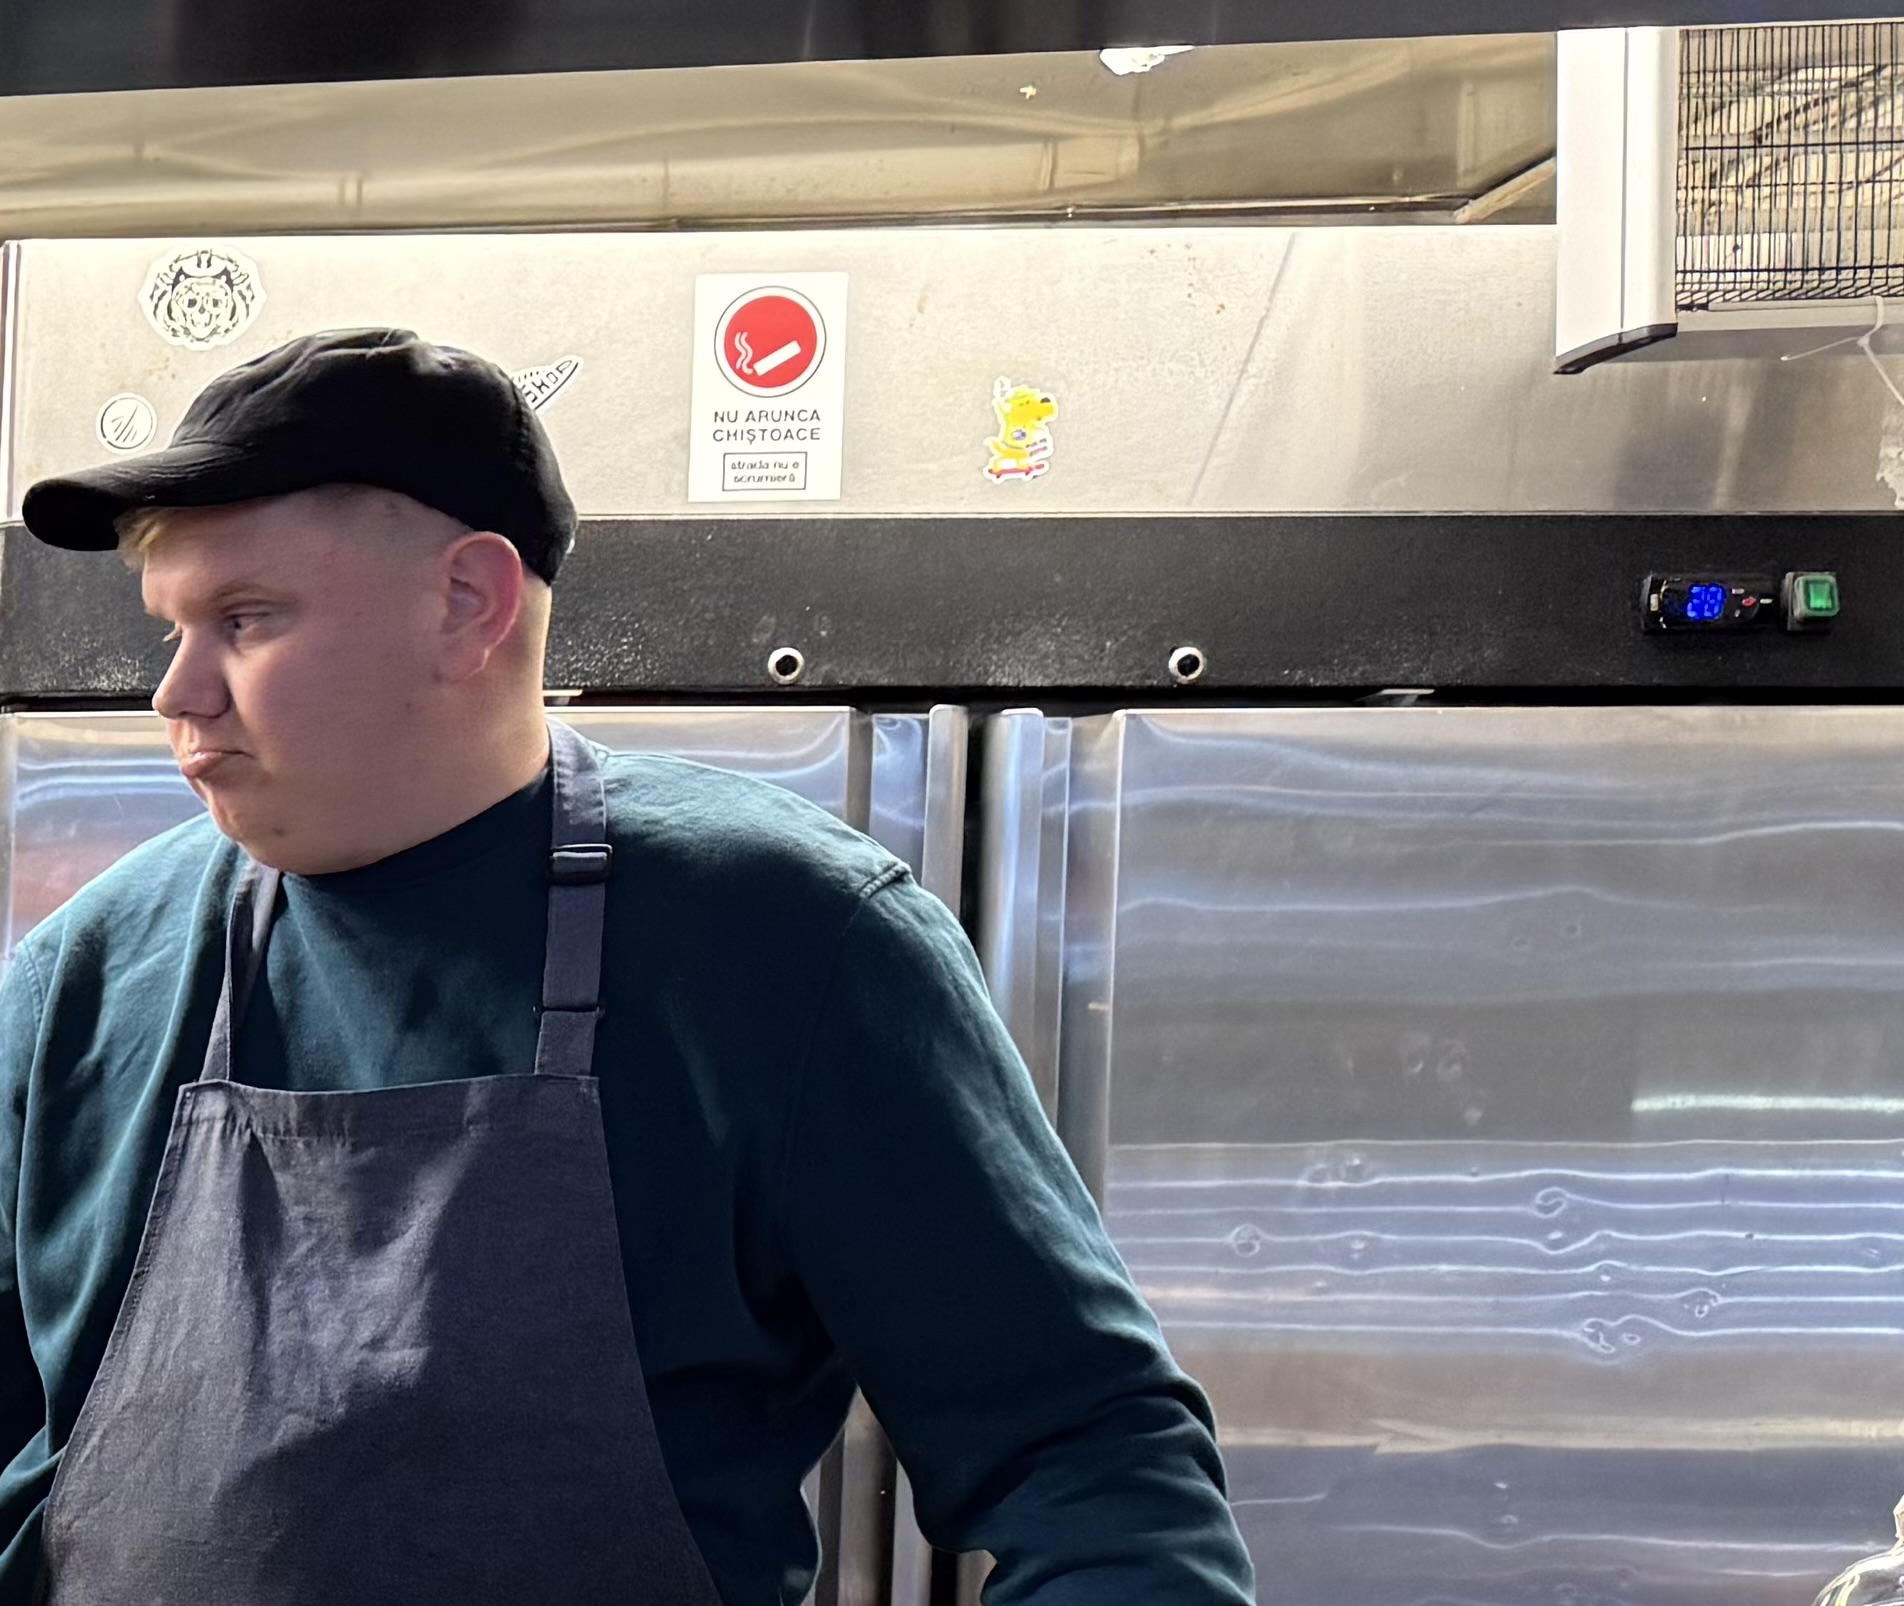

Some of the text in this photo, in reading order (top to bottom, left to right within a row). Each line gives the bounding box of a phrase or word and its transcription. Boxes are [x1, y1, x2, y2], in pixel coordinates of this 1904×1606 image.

[713, 409, 821, 423] NU ARUNCA
[712, 428, 821, 445] CHIȘTOACE
[730, 459, 799, 470] strada nu e
